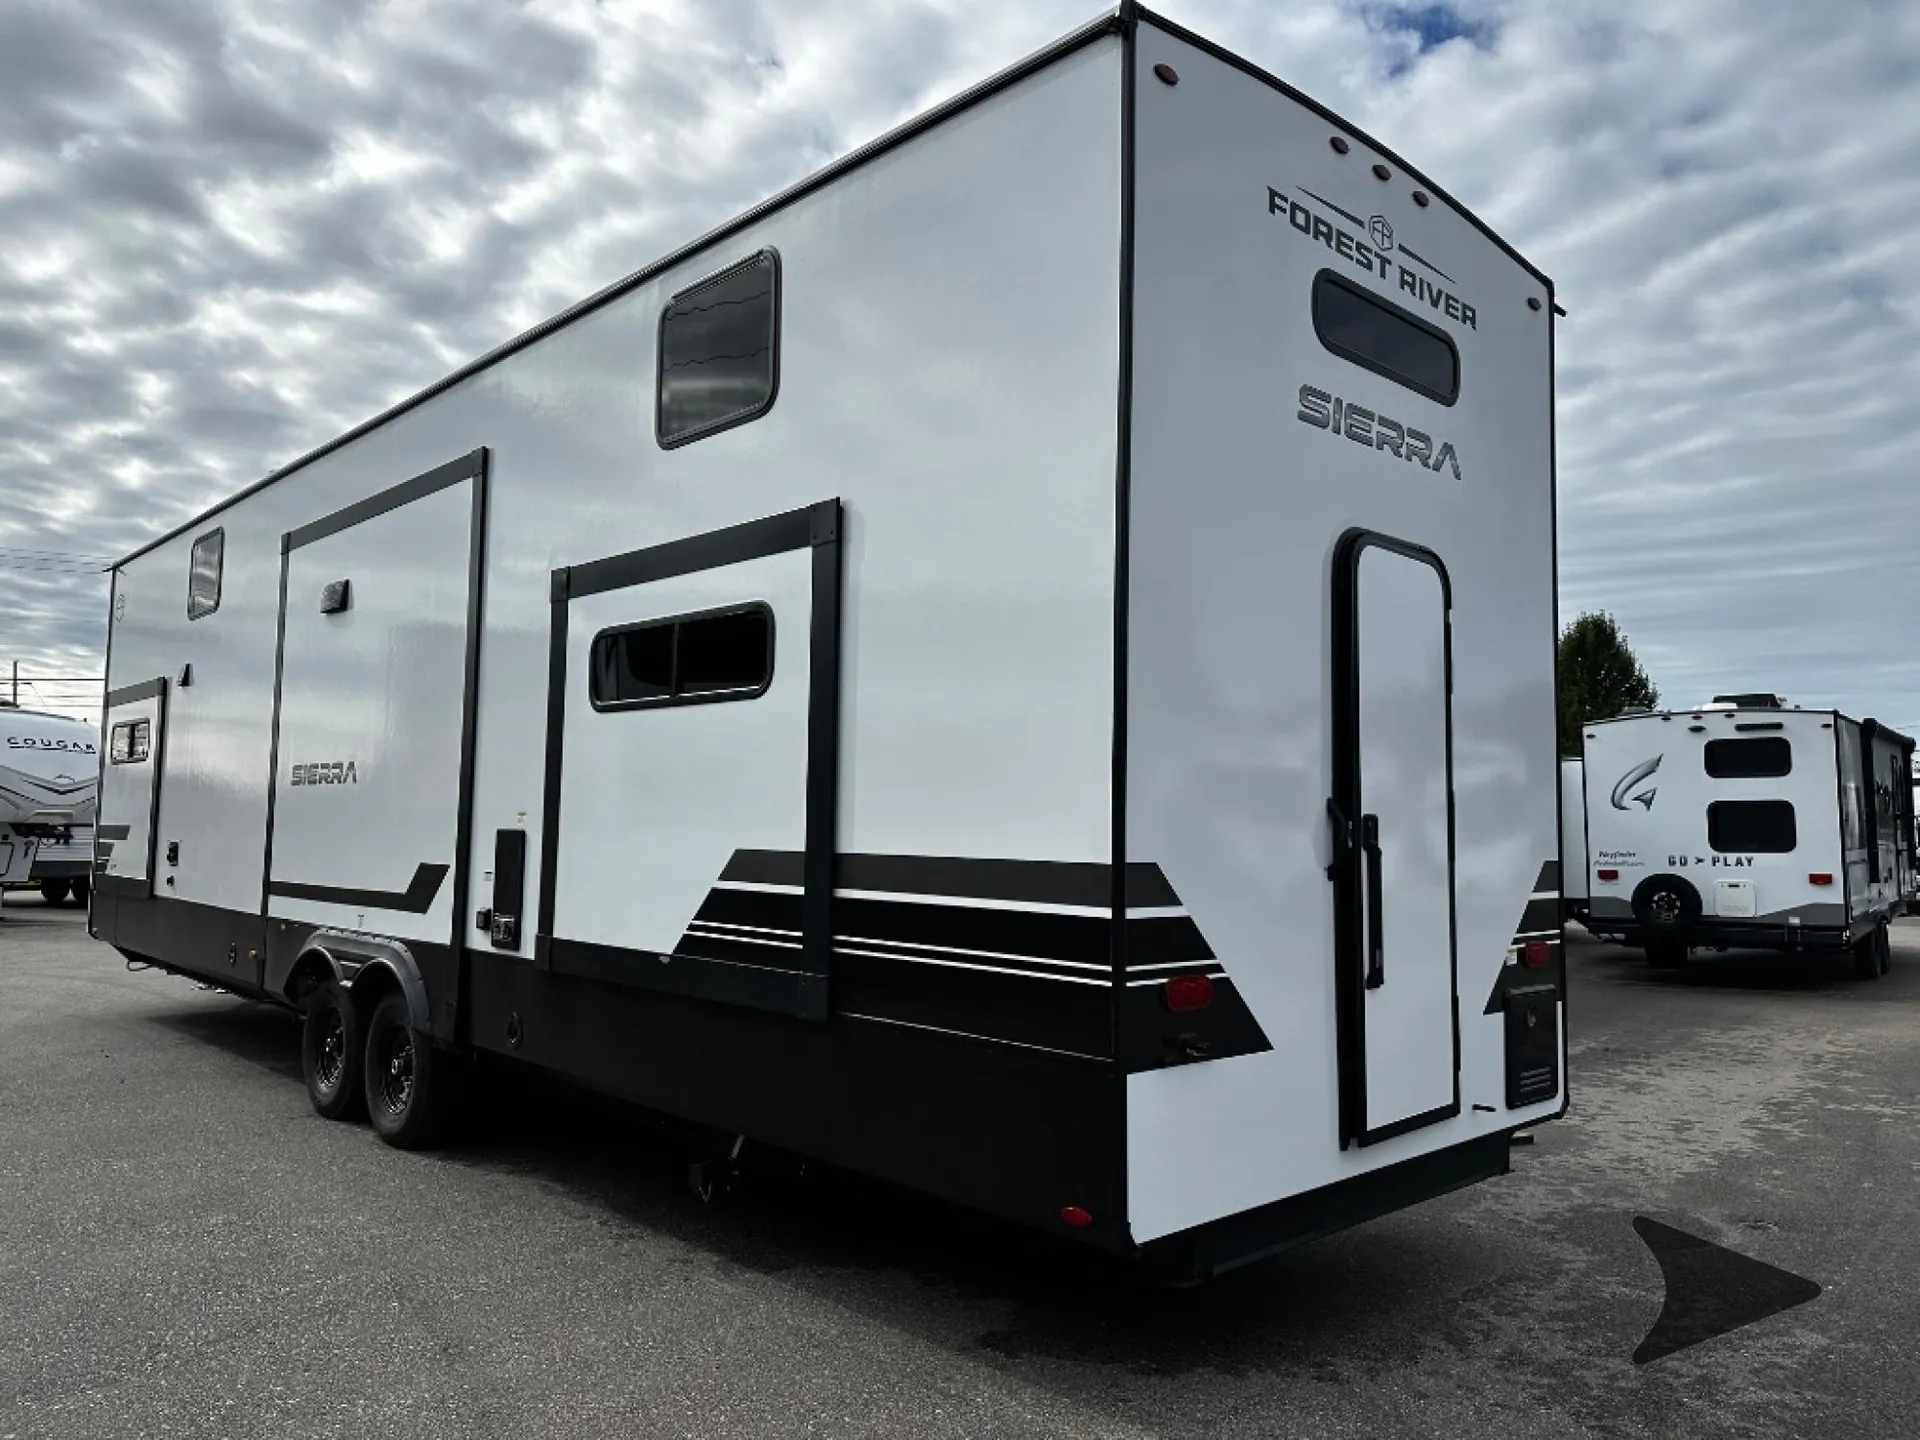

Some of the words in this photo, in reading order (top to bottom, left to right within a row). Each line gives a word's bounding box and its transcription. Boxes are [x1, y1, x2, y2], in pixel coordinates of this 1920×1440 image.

[1266, 186, 1392, 279] FOREST
[1398, 265, 1477, 330] RIVER
[1297, 384, 1462, 481] SIERRA
[7, 737, 96, 752] COUGAR
[291, 761, 357, 786] SIERRA
[1668, 855, 1689, 867] GO
[1711, 856, 1754, 867] PLAY
